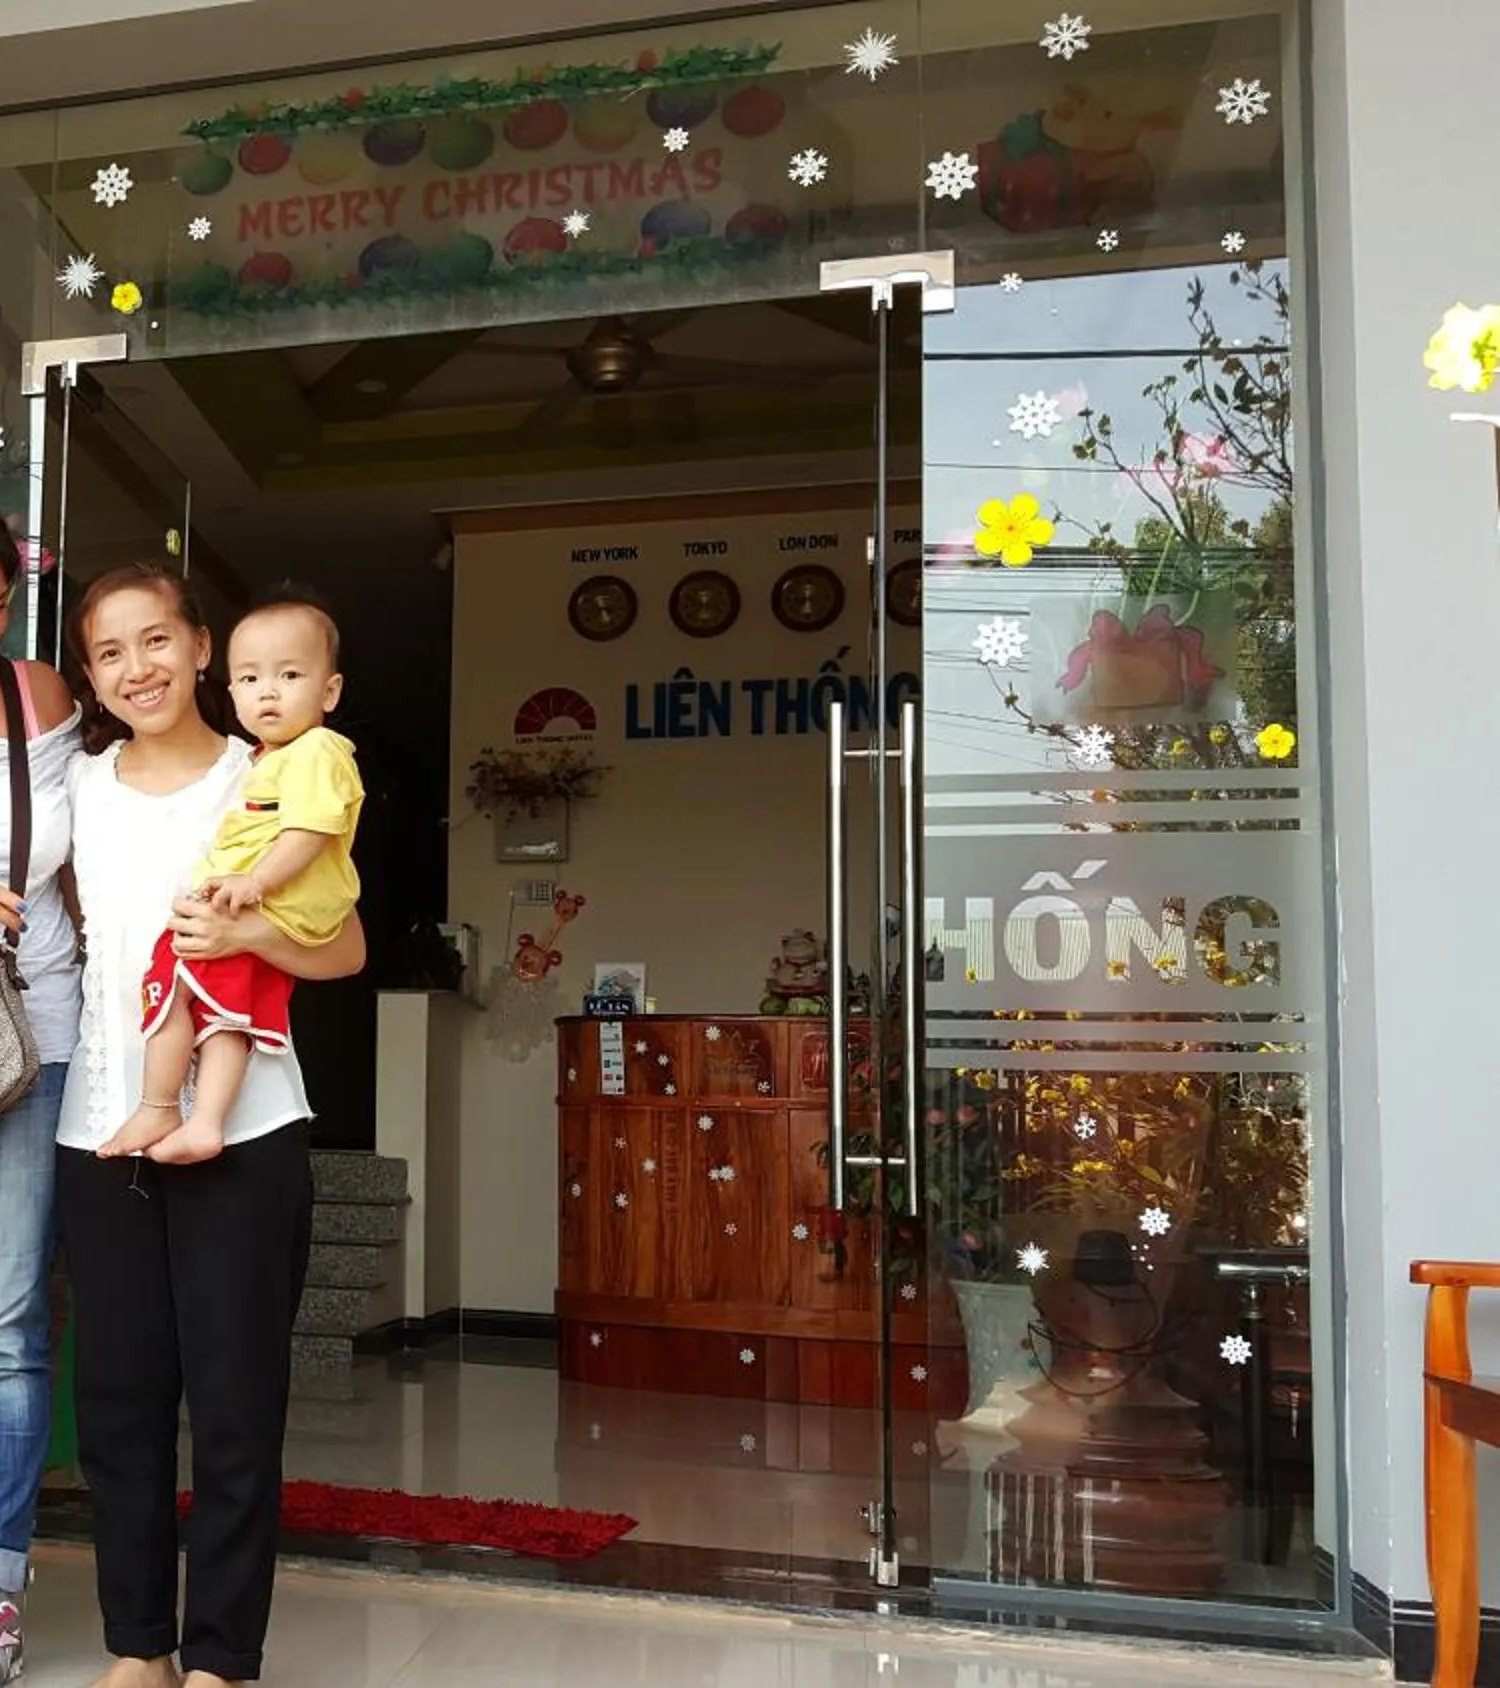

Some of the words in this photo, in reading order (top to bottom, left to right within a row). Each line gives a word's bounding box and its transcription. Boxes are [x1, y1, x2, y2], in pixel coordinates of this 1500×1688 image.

[236, 185, 406, 242] MERRY
[422, 147, 726, 222] CHRISTMAS
[571, 548, 600, 563] NEW
[603, 545, 639, 561] YORK
[683, 541, 728, 556] TOKYO
[625, 667, 732, 739] LIÊN
